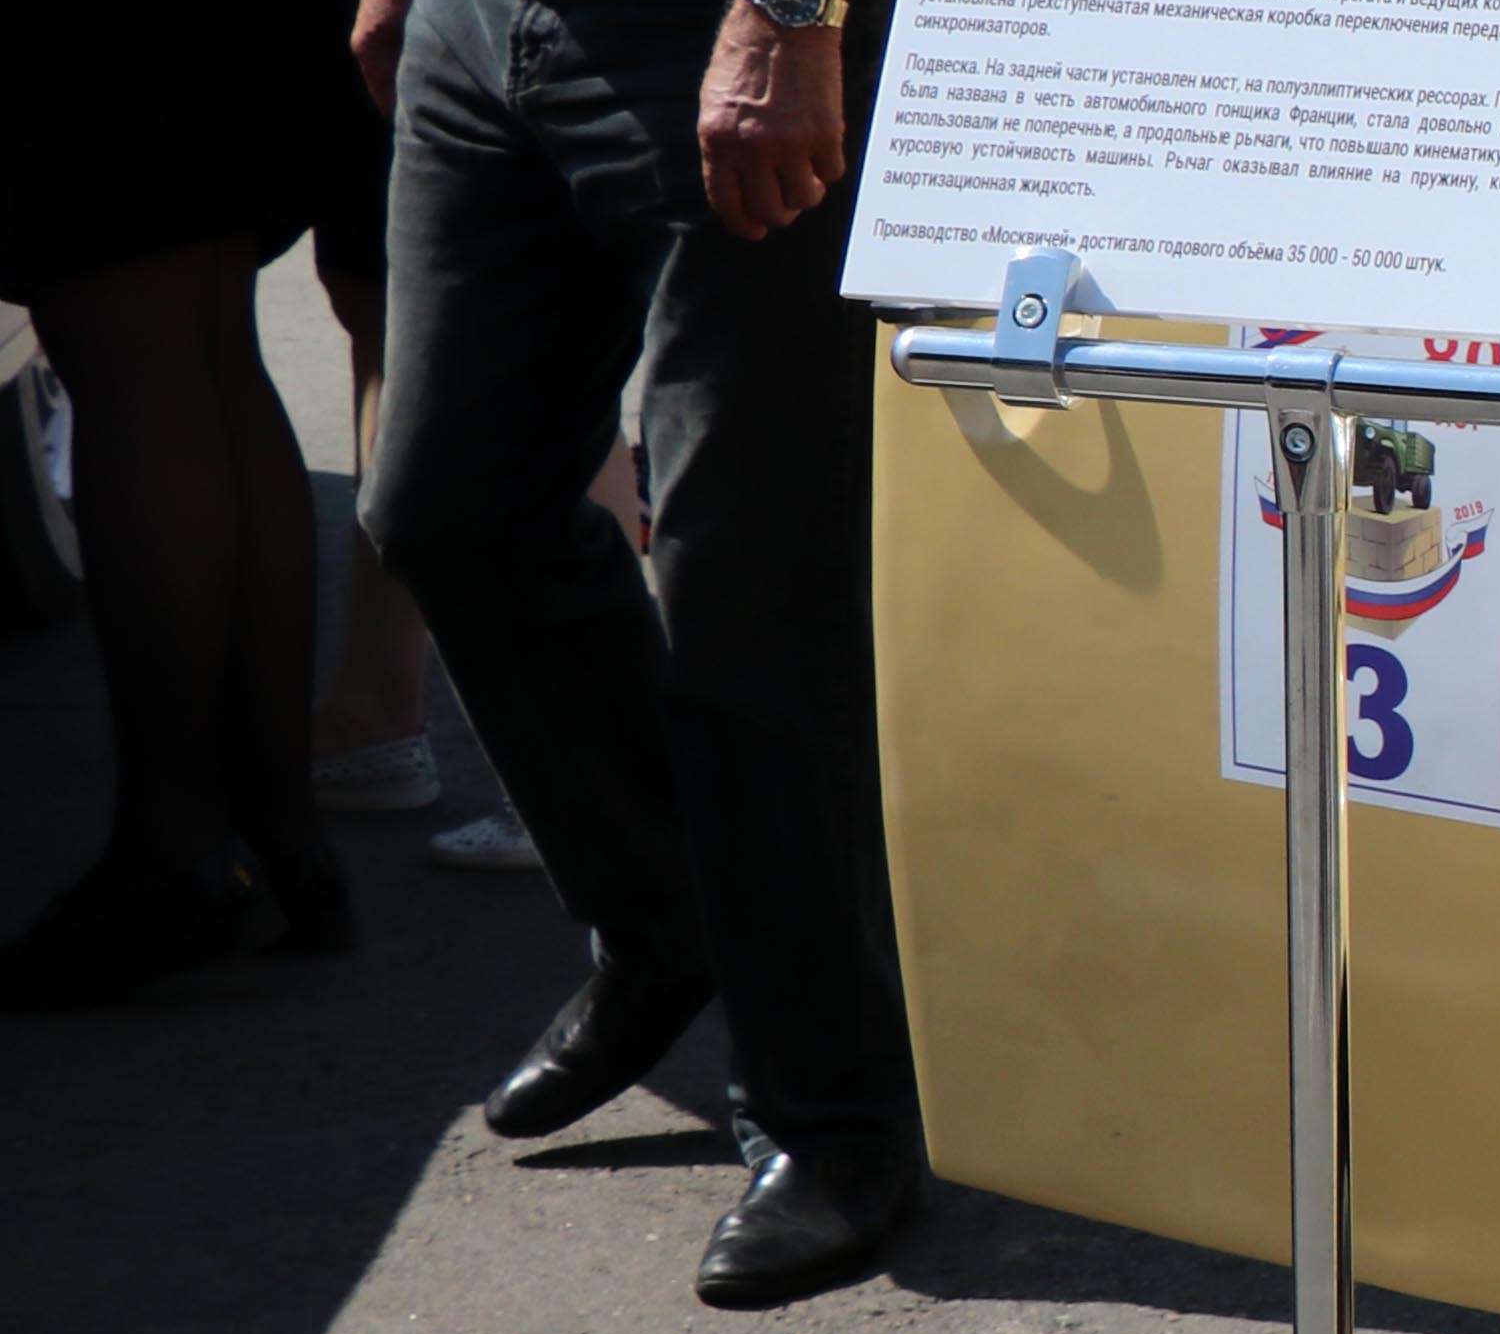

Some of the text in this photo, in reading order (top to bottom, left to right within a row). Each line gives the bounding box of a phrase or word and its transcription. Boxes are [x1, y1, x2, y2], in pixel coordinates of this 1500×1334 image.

[872, 216, 979, 244] Производство
[980, 224, 1077, 248] «Москвичей»
[1076, 233, 1155, 254] достигало
[1156, 238, 1225, 259] годового
[1226, 239, 1284, 262] объёма
[1307, 244, 1339, 265] 000
[1372, 248, 1404, 270] 000
[1403, 255, 1447, 276] штук.
[1453, 499, 1485, 521] 2019
